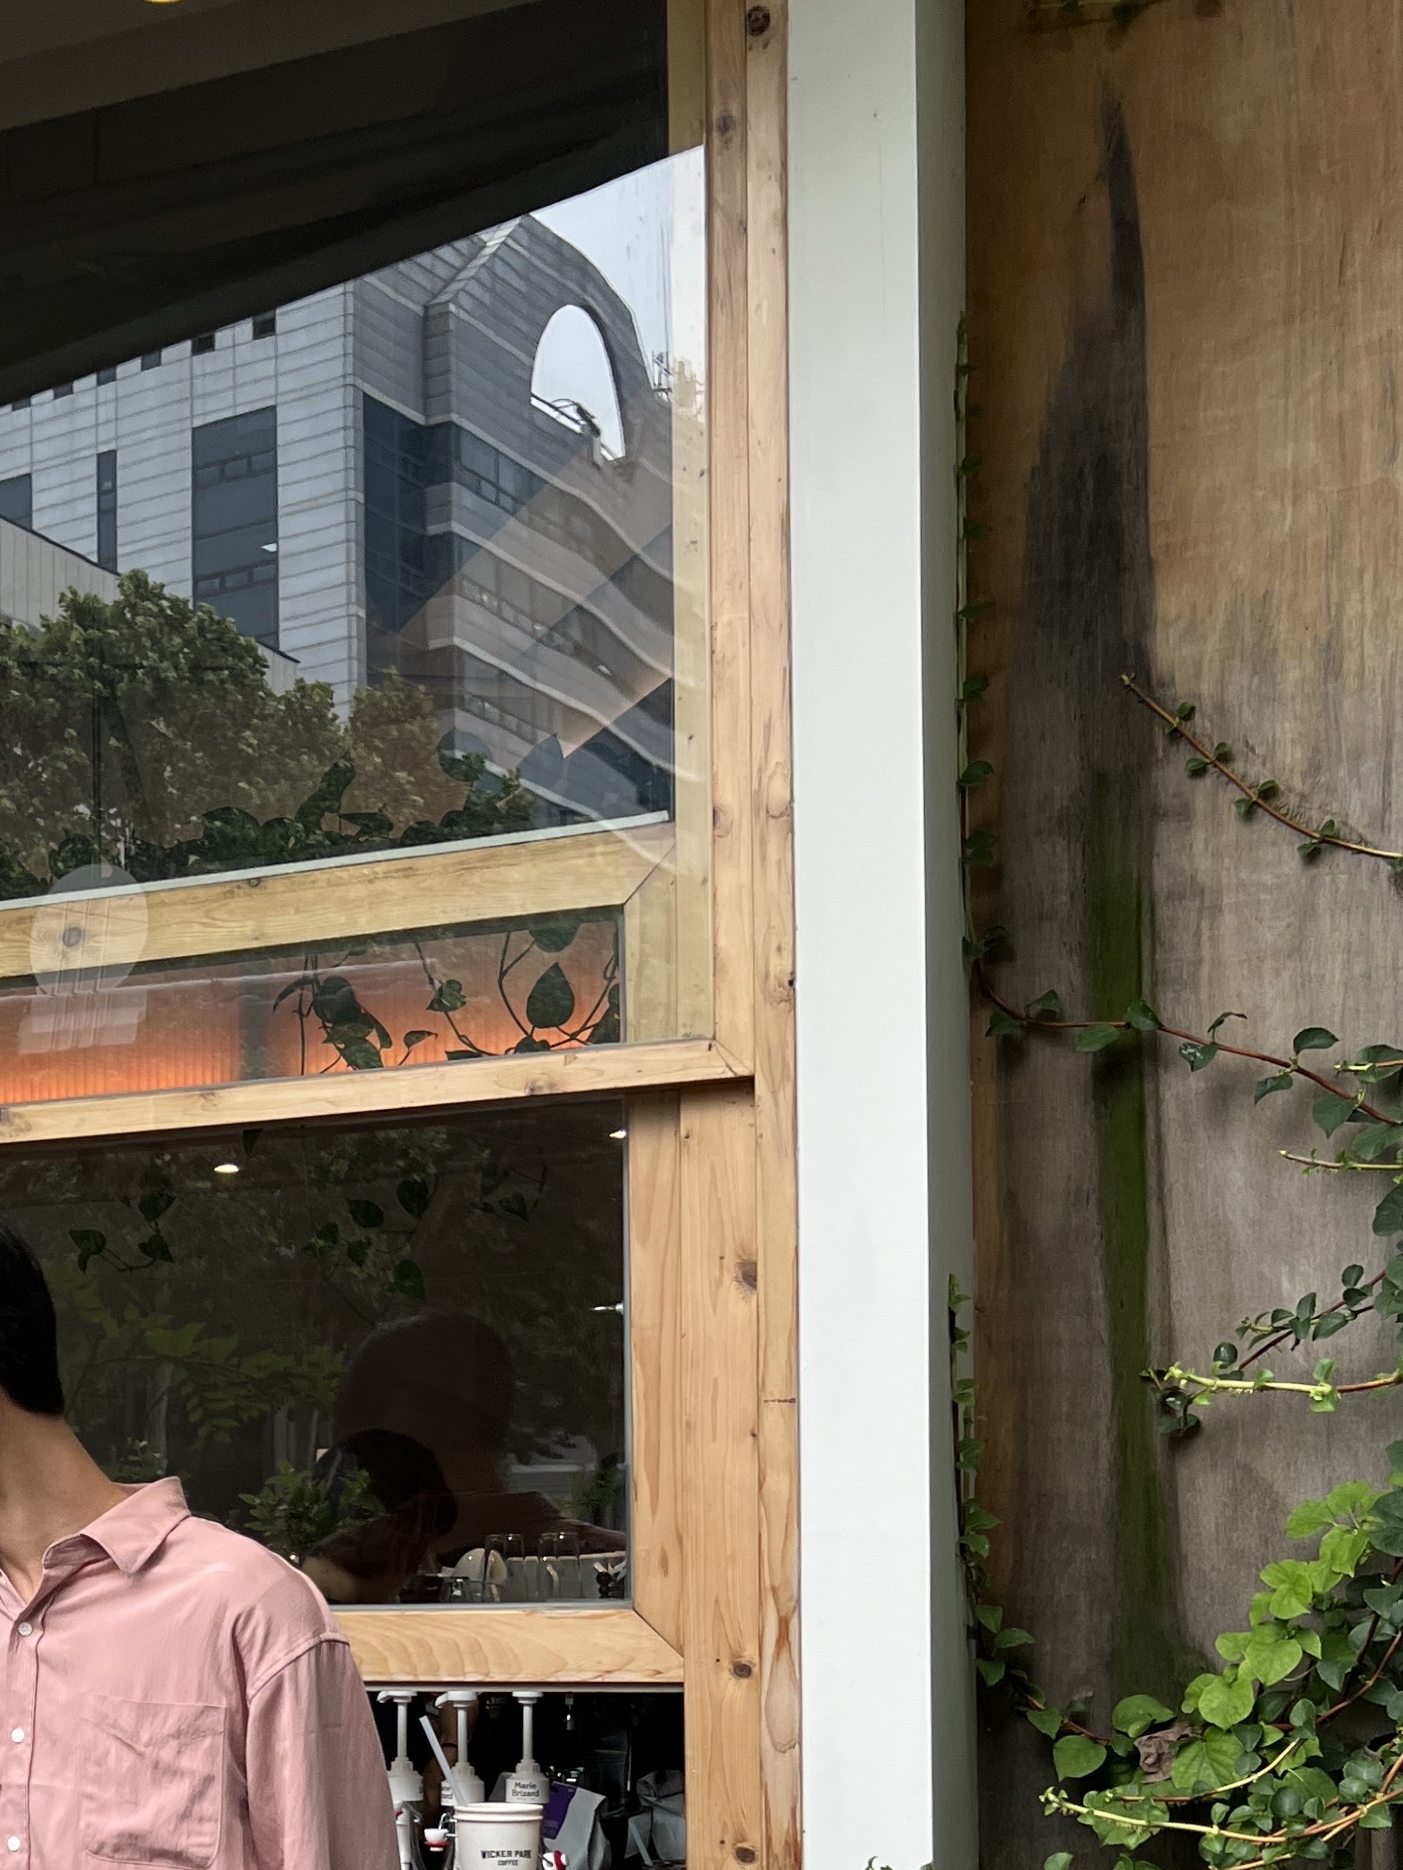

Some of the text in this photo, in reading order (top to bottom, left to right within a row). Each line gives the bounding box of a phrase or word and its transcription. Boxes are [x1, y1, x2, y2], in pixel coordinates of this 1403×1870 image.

[512, 1788, 539, 1796] Brizard
[481, 1850, 532, 1859] WICKER PARK
